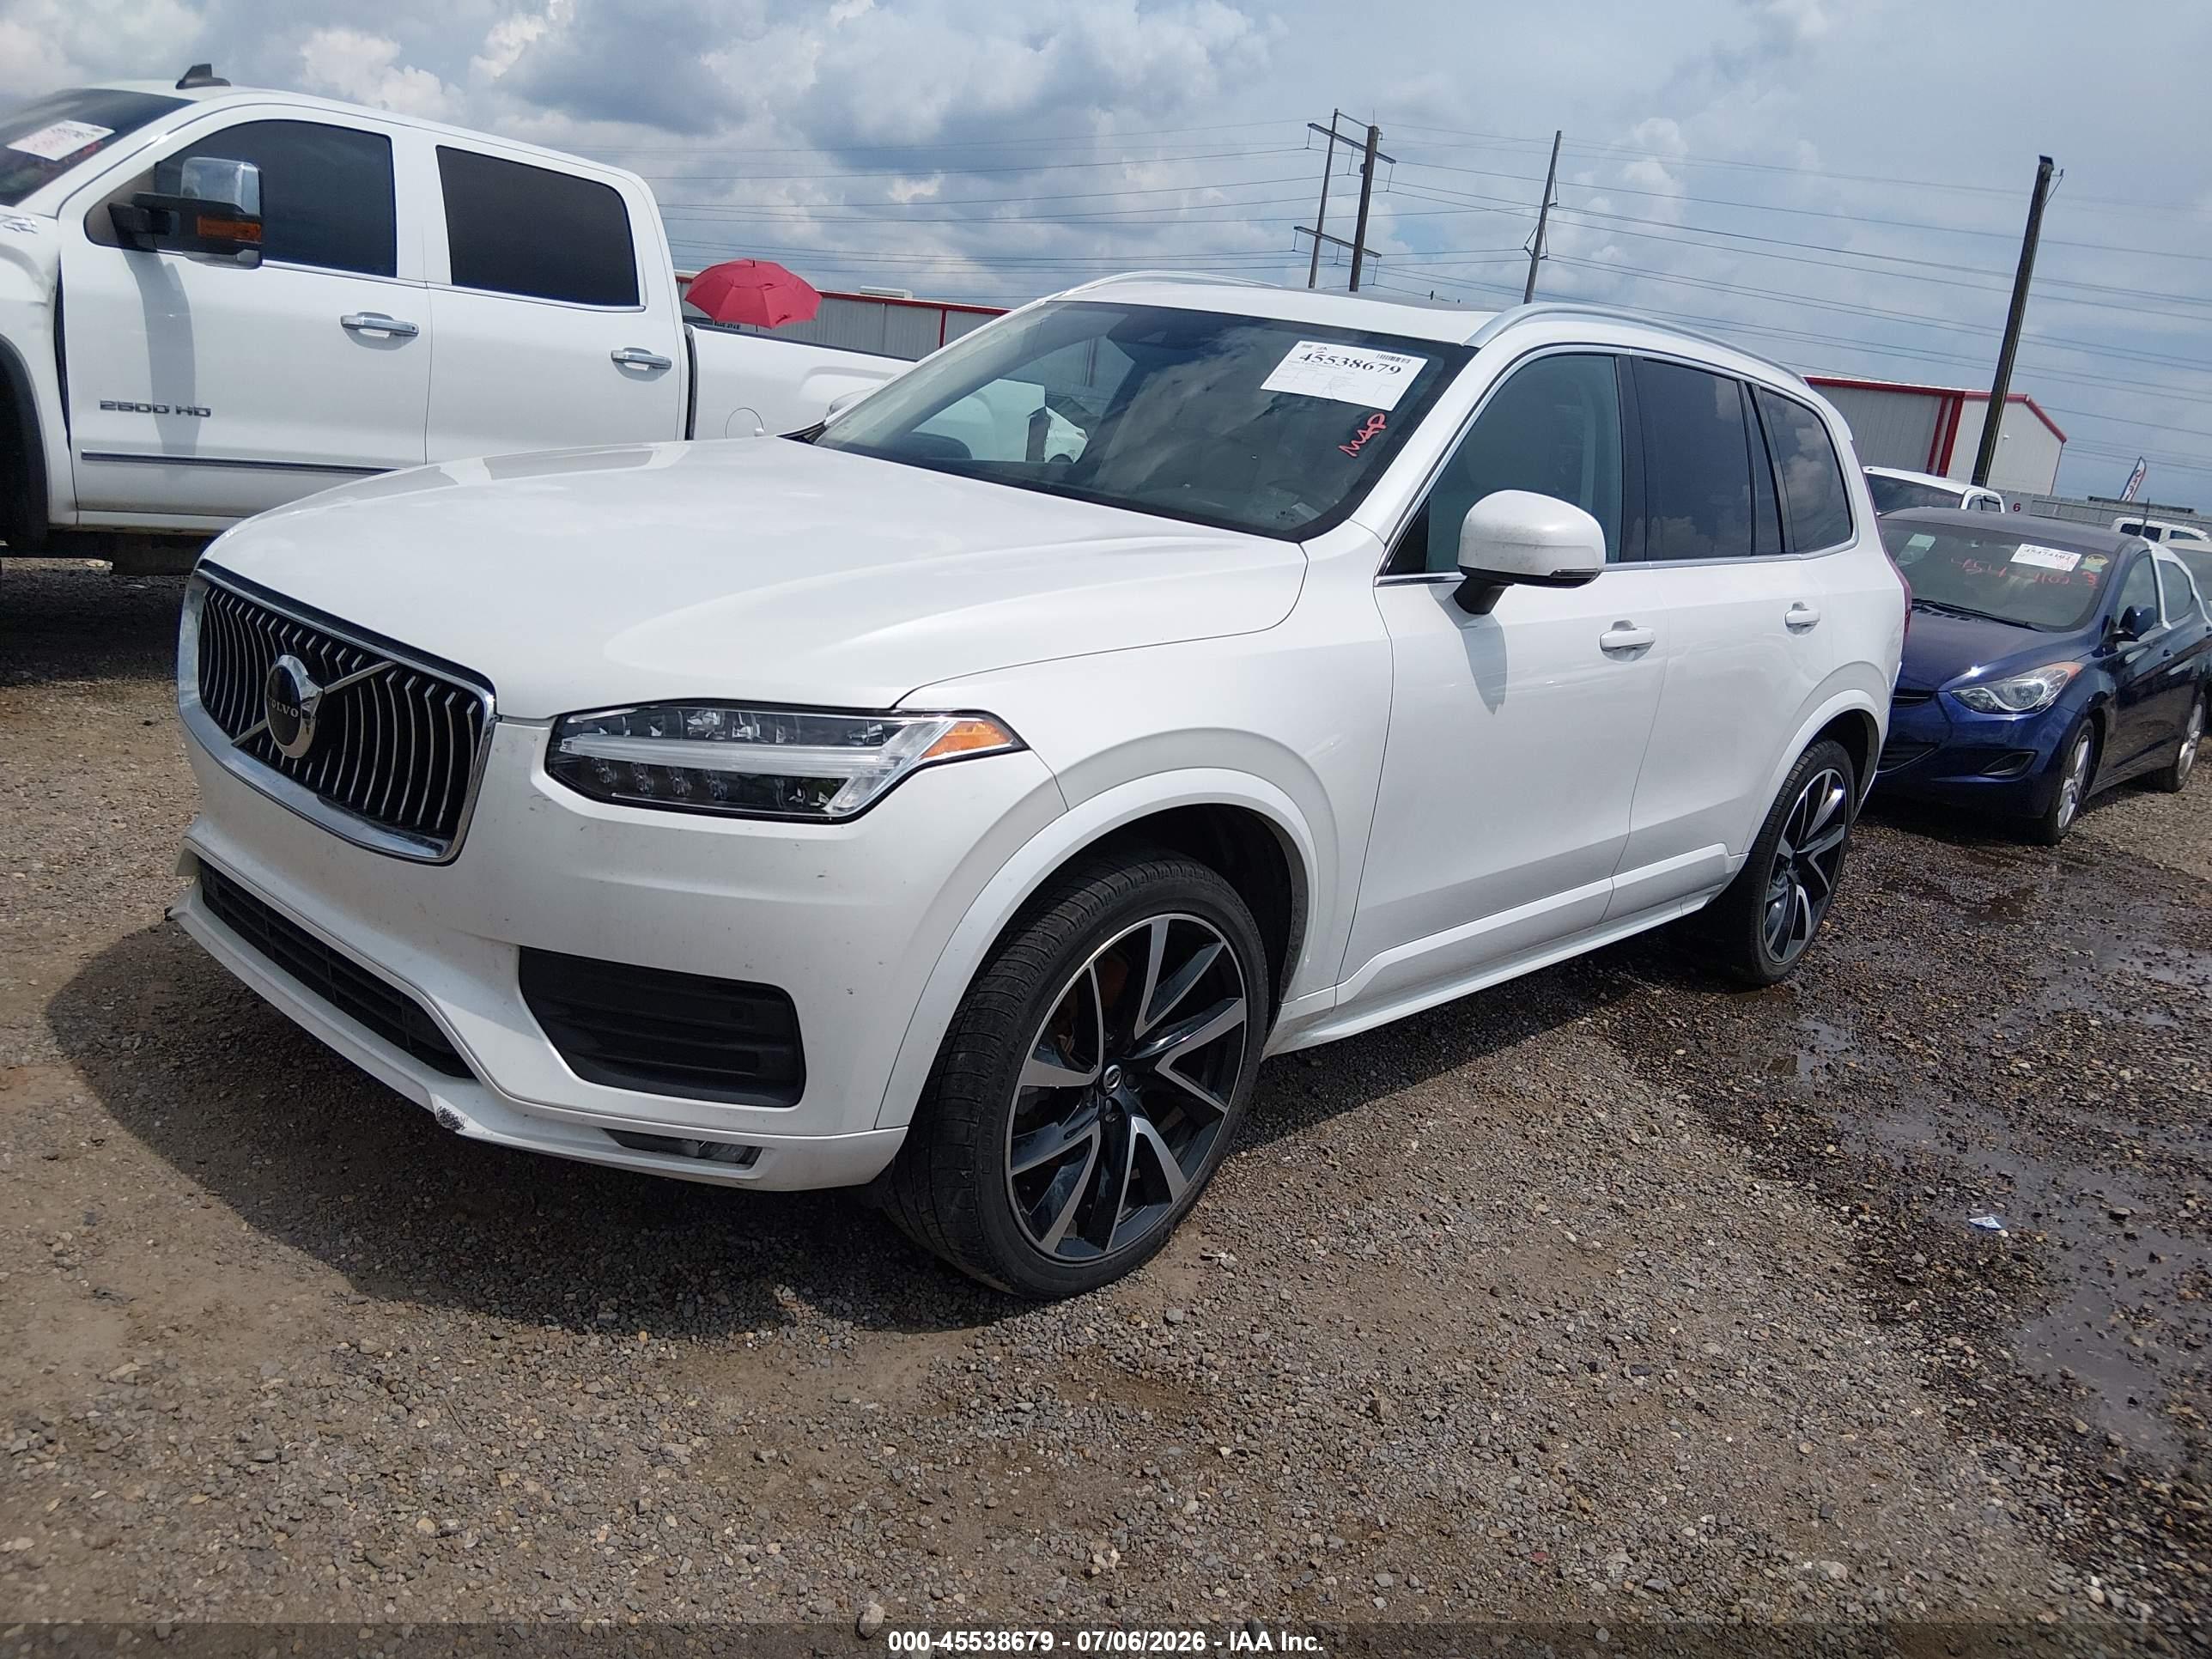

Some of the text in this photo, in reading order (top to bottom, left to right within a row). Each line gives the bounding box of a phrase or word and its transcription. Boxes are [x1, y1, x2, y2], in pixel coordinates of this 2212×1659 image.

[1298, 351, 1401, 375] 45538679
[100, 400, 212, 417] 2500 HD
[2013, 502, 2021, 513] 6
